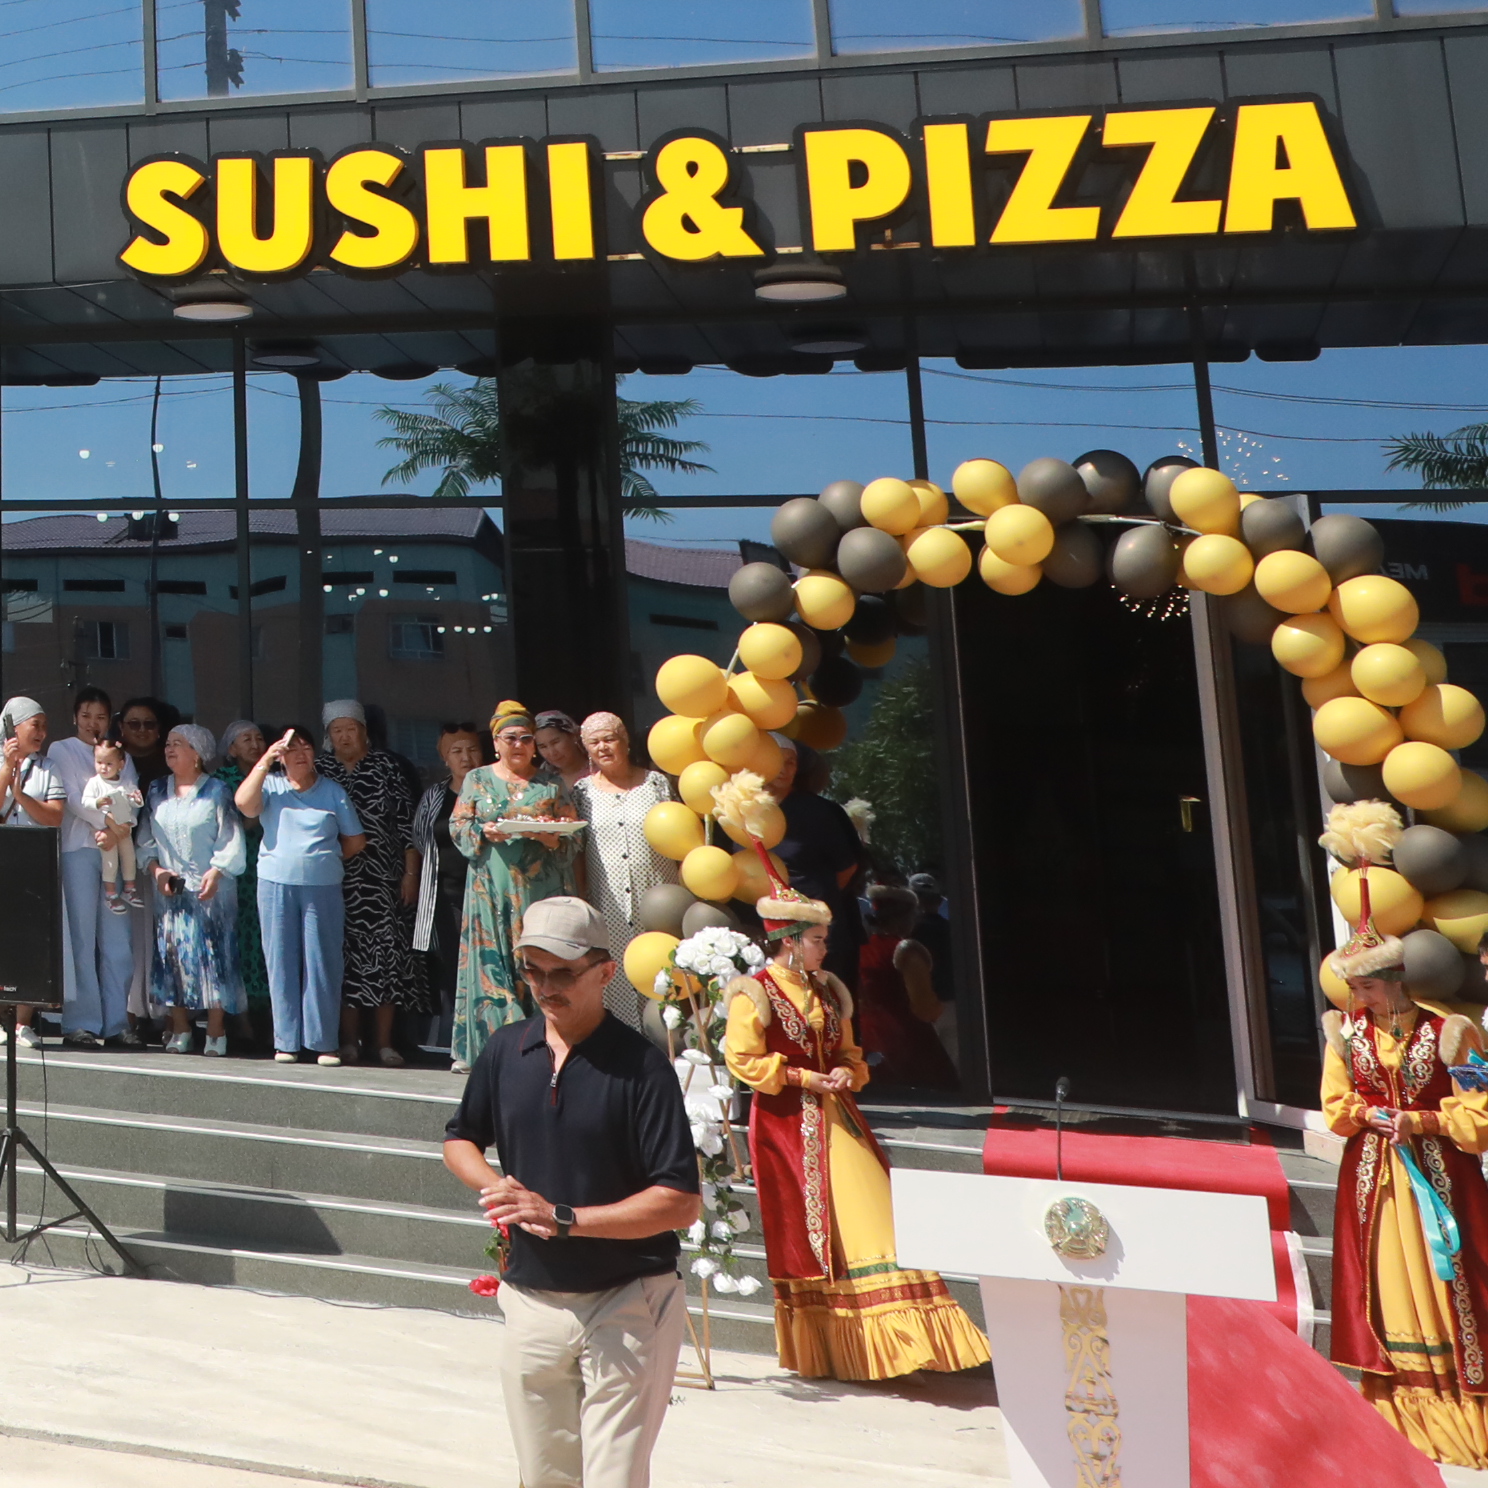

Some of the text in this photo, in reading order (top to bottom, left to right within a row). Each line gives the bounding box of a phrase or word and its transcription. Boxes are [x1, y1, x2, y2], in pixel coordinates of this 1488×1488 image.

[120, 102, 1360, 277] SUSHI & PIZZA
